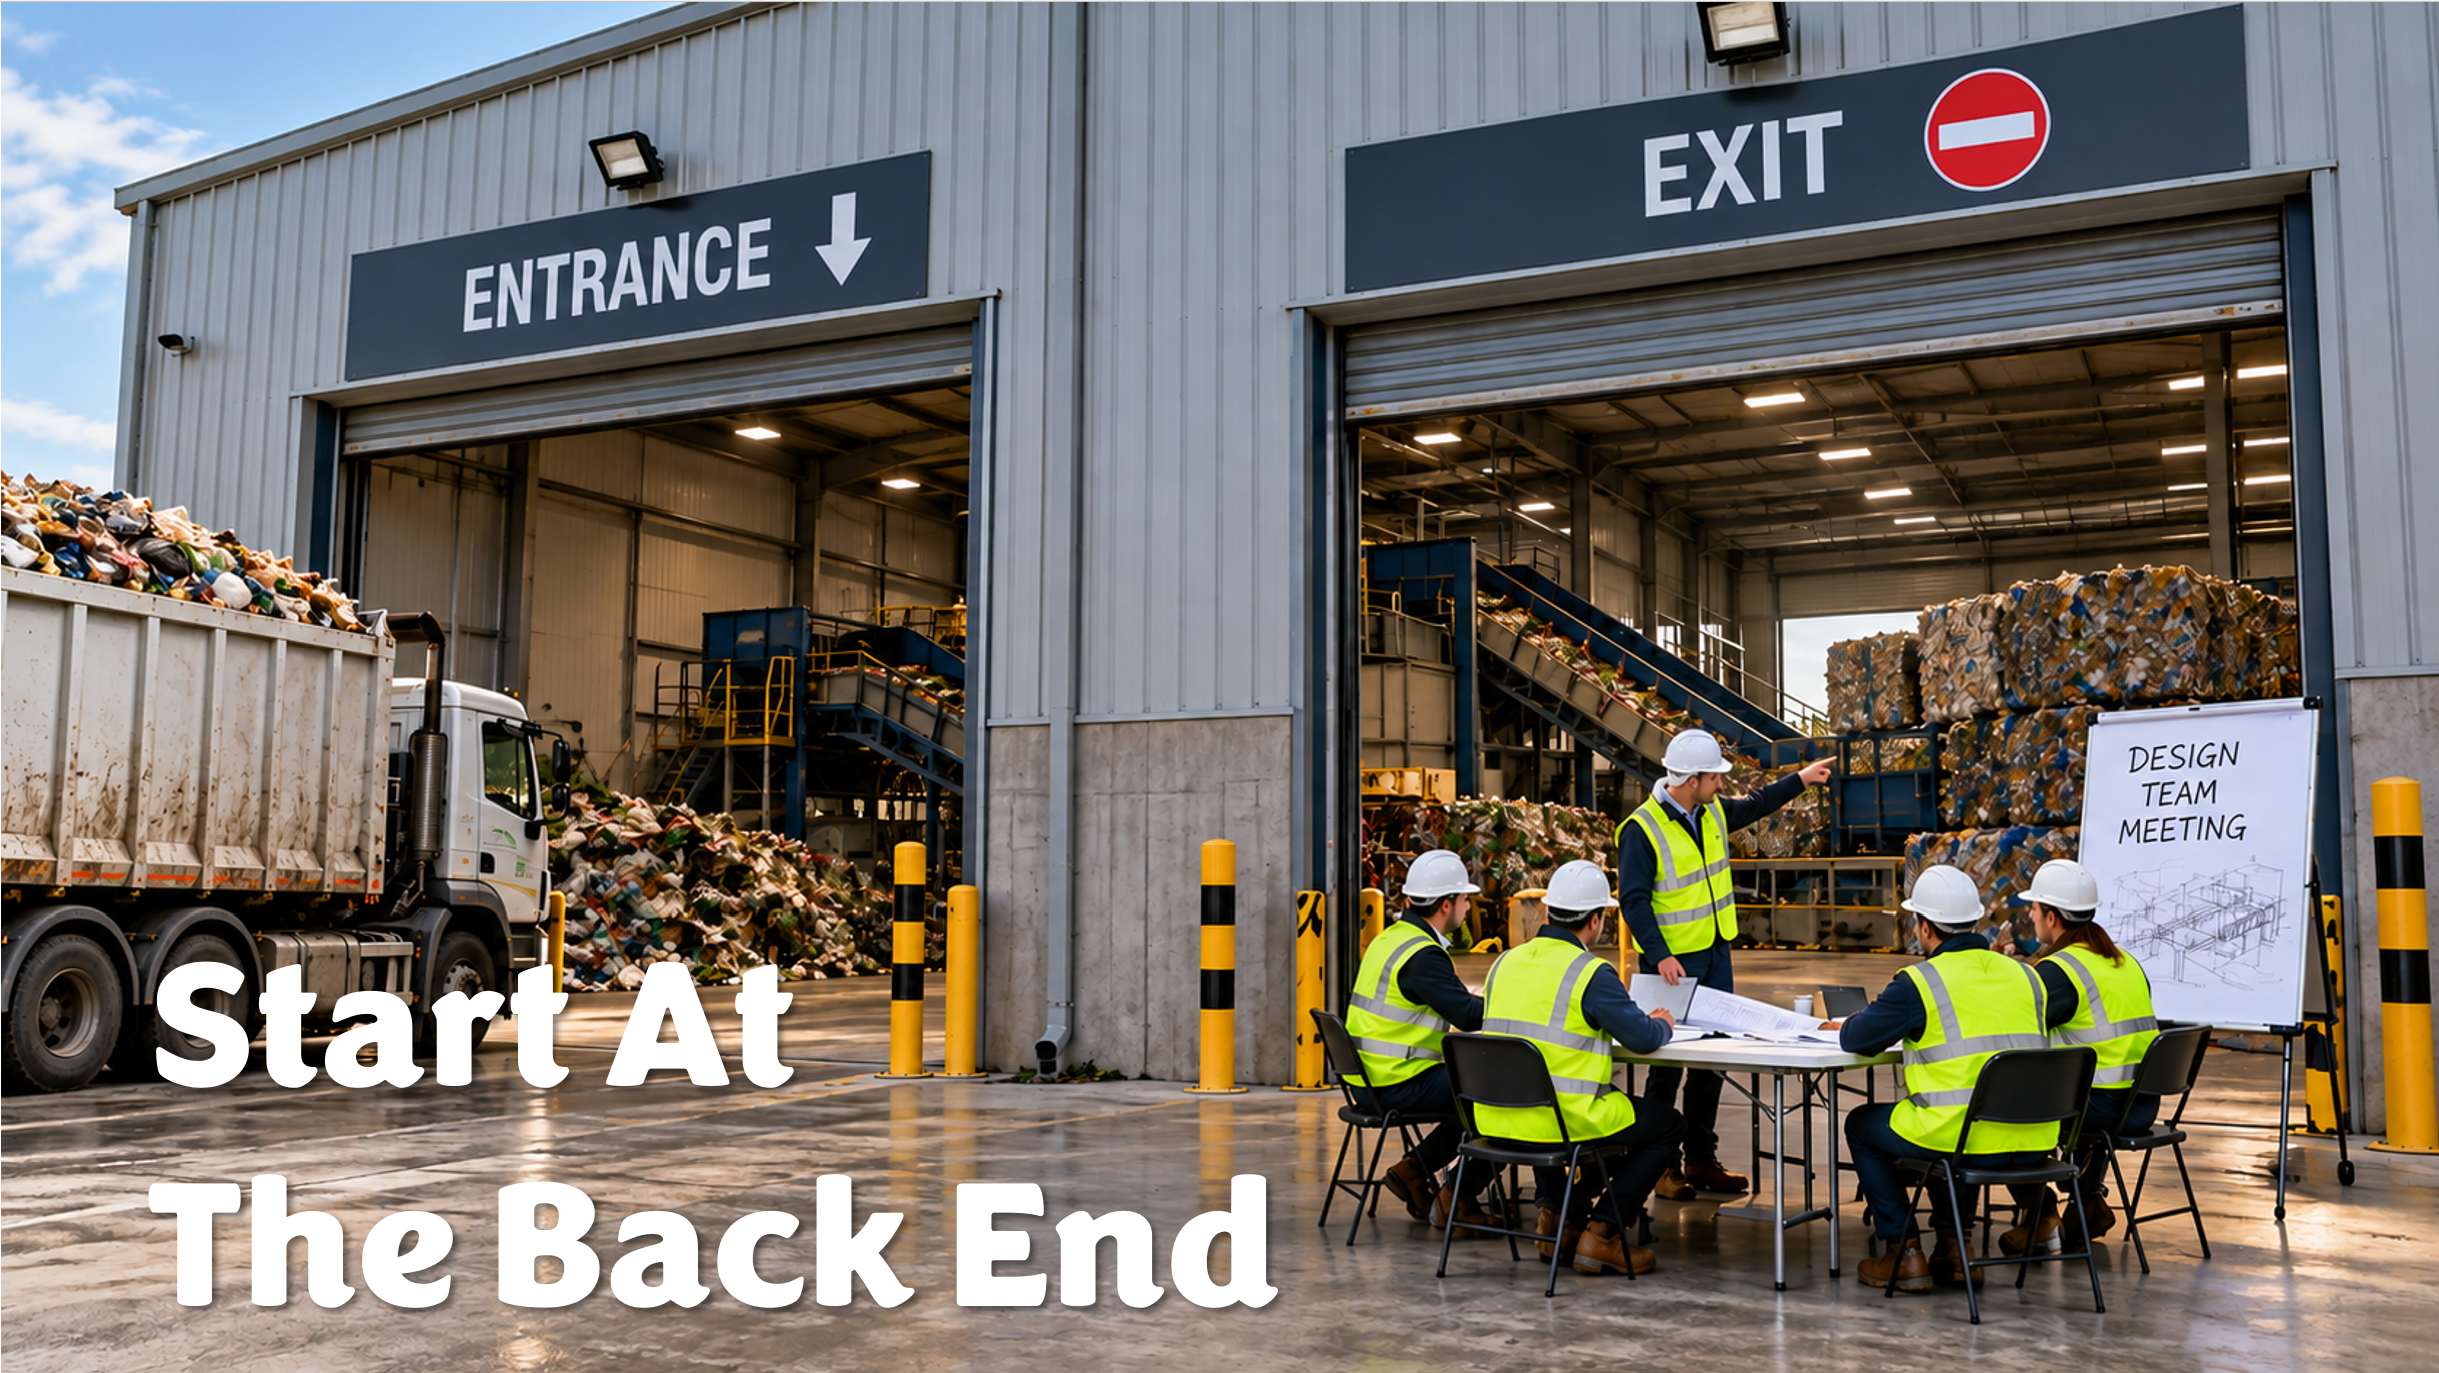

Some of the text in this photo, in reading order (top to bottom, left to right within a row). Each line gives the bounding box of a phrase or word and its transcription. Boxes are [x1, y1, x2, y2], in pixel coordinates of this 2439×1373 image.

[1644, 110, 1843, 218] EXIT
[464, 217, 771, 332] ENTRANCE
[2129, 741, 2240, 773] DESIGN
[2141, 779, 2217, 807] TEAM
[2118, 813, 2247, 845] MEETING
